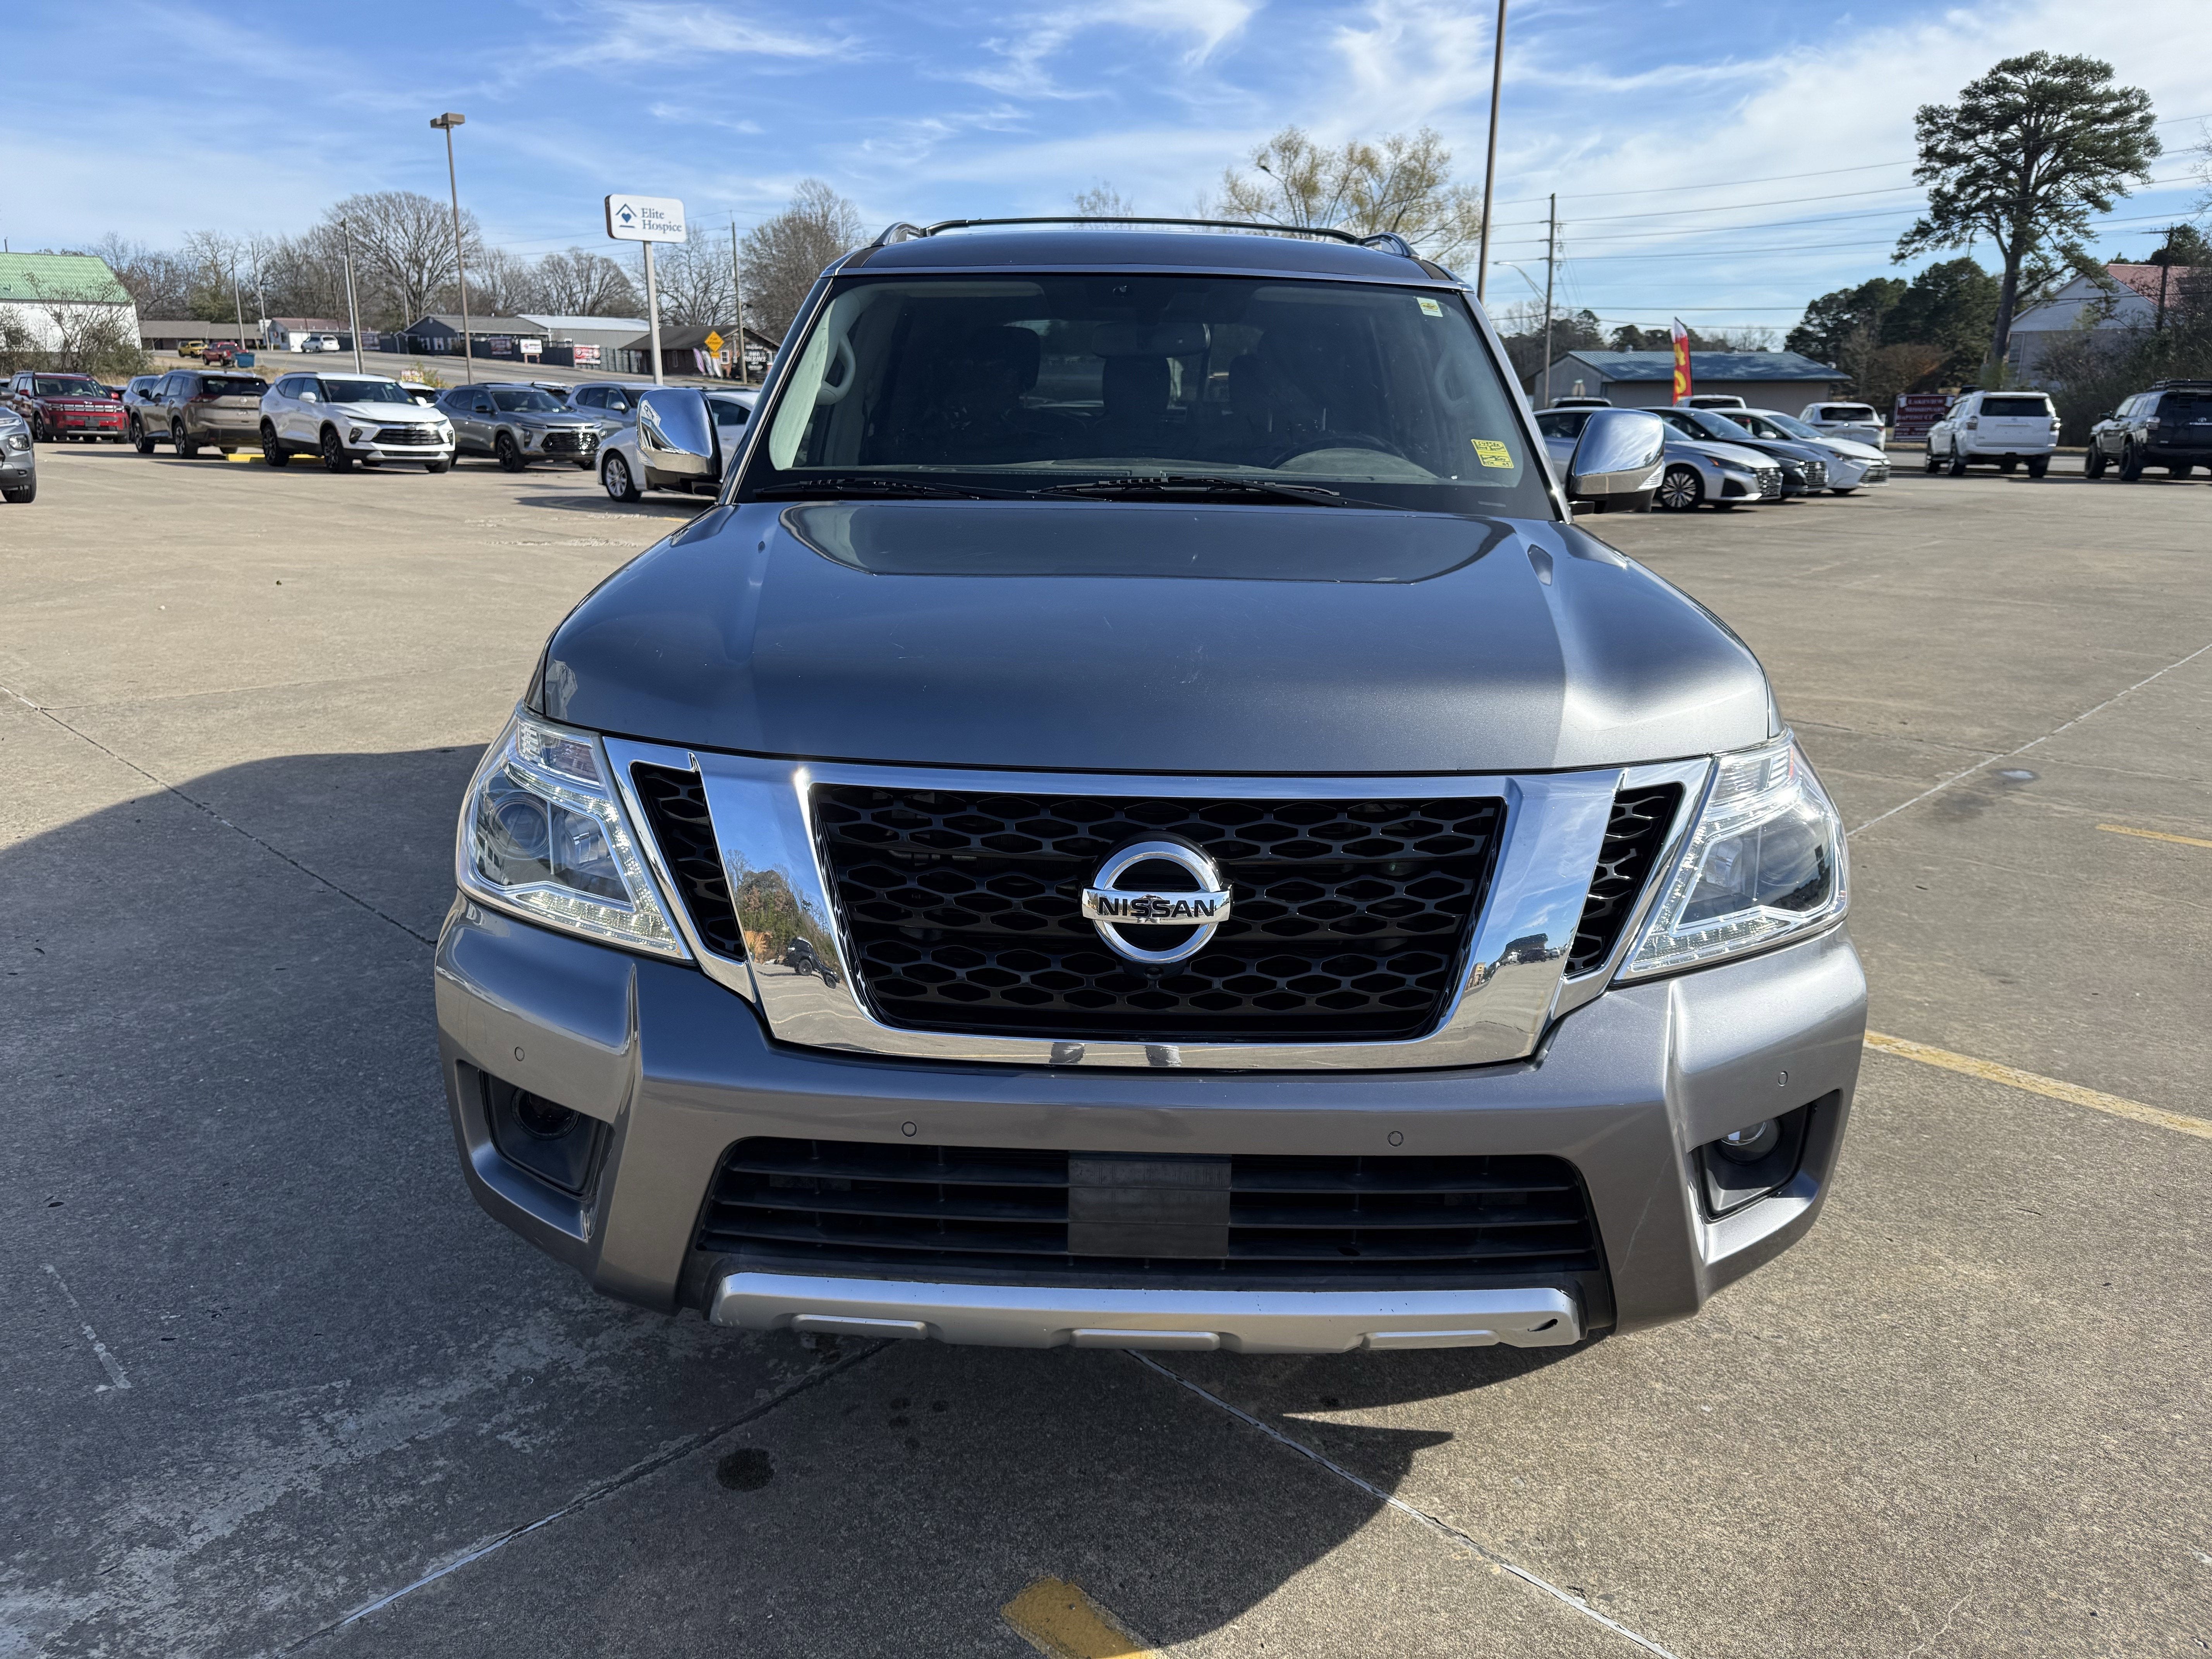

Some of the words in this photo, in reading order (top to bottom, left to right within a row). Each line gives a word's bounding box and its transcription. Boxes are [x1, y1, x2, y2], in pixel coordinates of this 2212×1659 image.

[641, 208, 665, 219] Elite
[642, 220, 682, 234] Hospice
[1098, 896, 1215, 917] NISSAN
